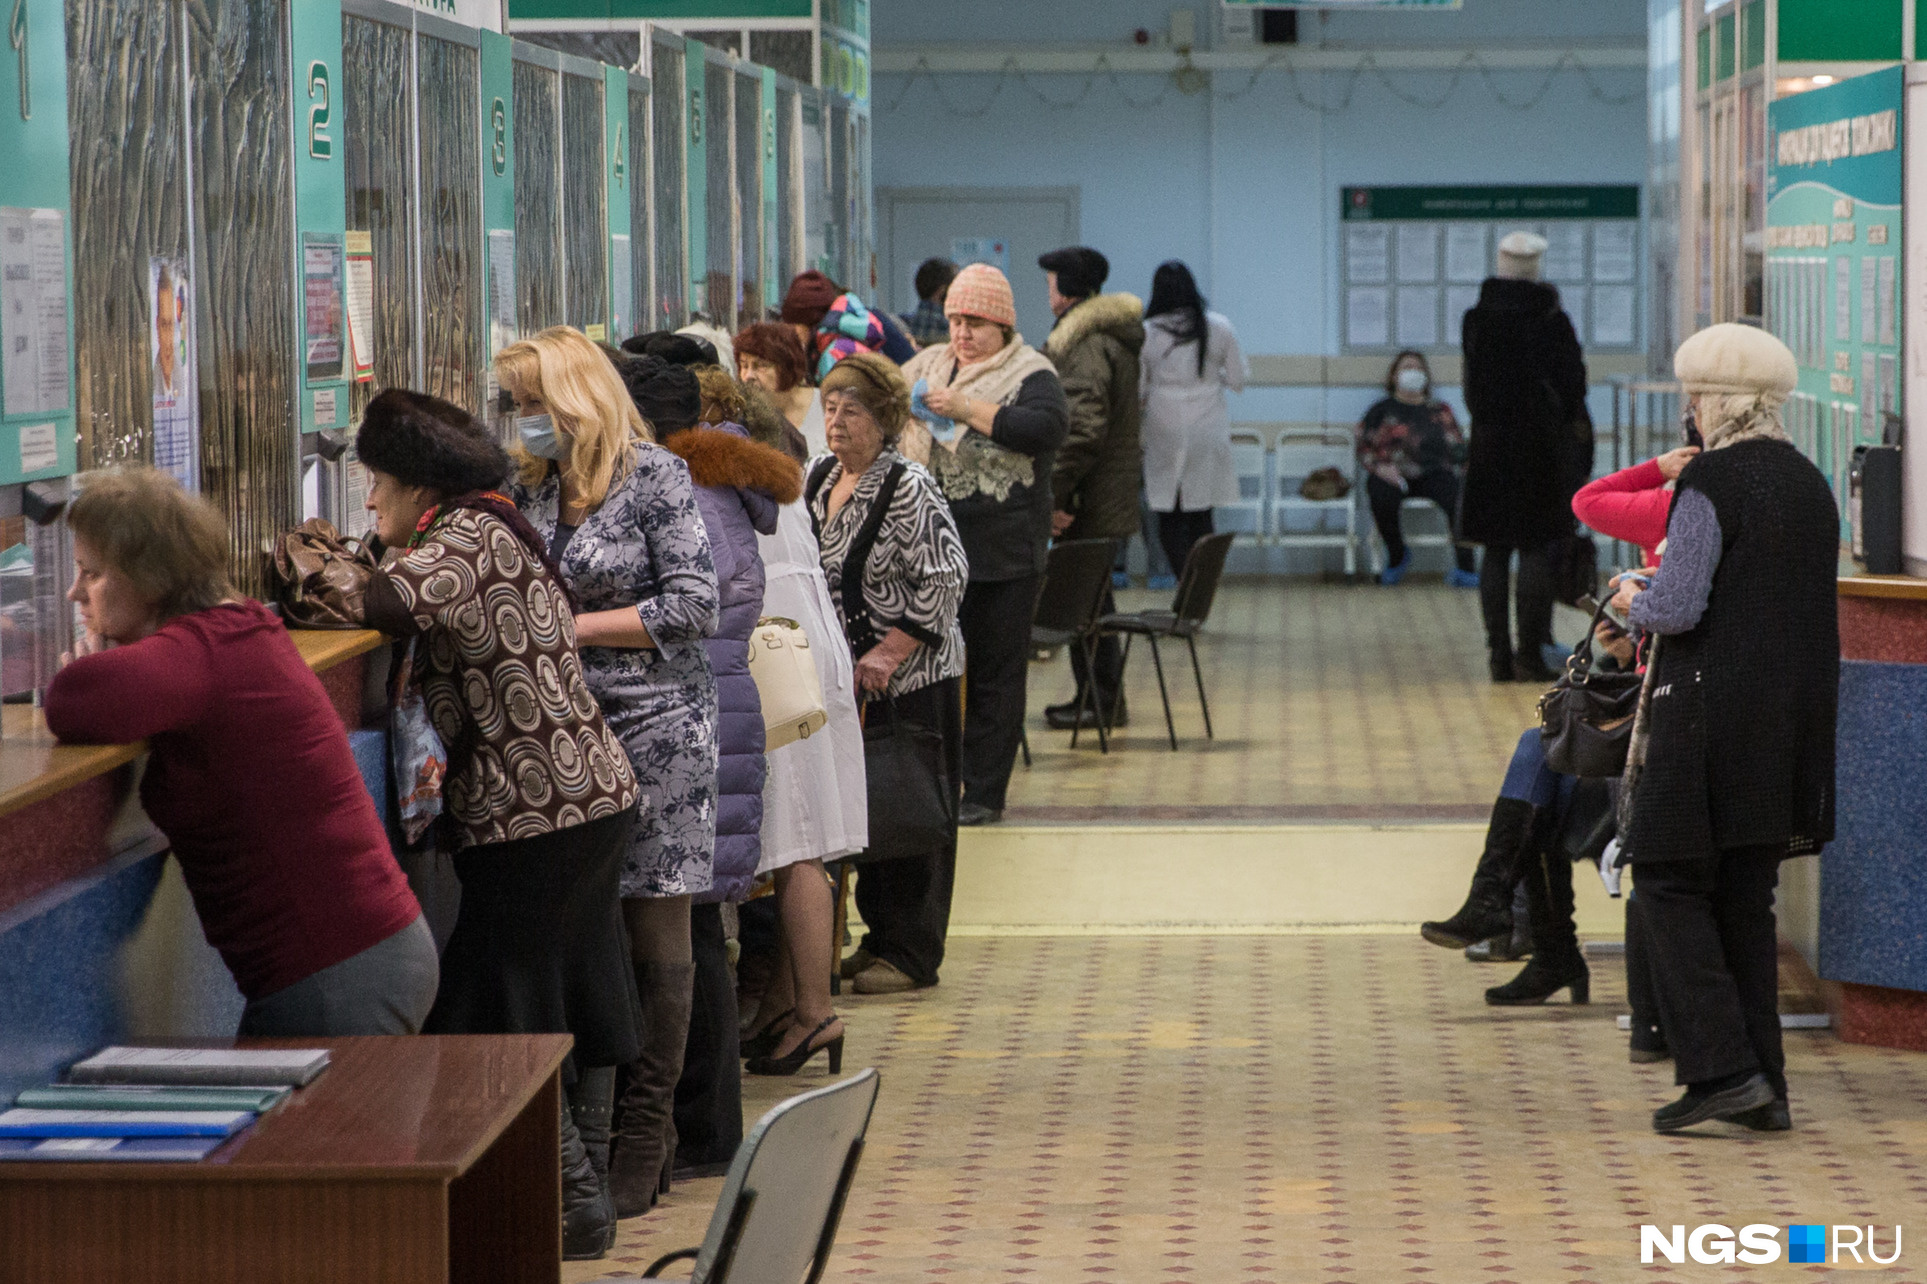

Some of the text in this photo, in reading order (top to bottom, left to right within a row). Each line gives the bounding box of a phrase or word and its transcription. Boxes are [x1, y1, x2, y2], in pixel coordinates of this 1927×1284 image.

[307, 59, 332, 160] 2
[491, 96, 506, 177] 3
[612, 121, 624, 191] 4
